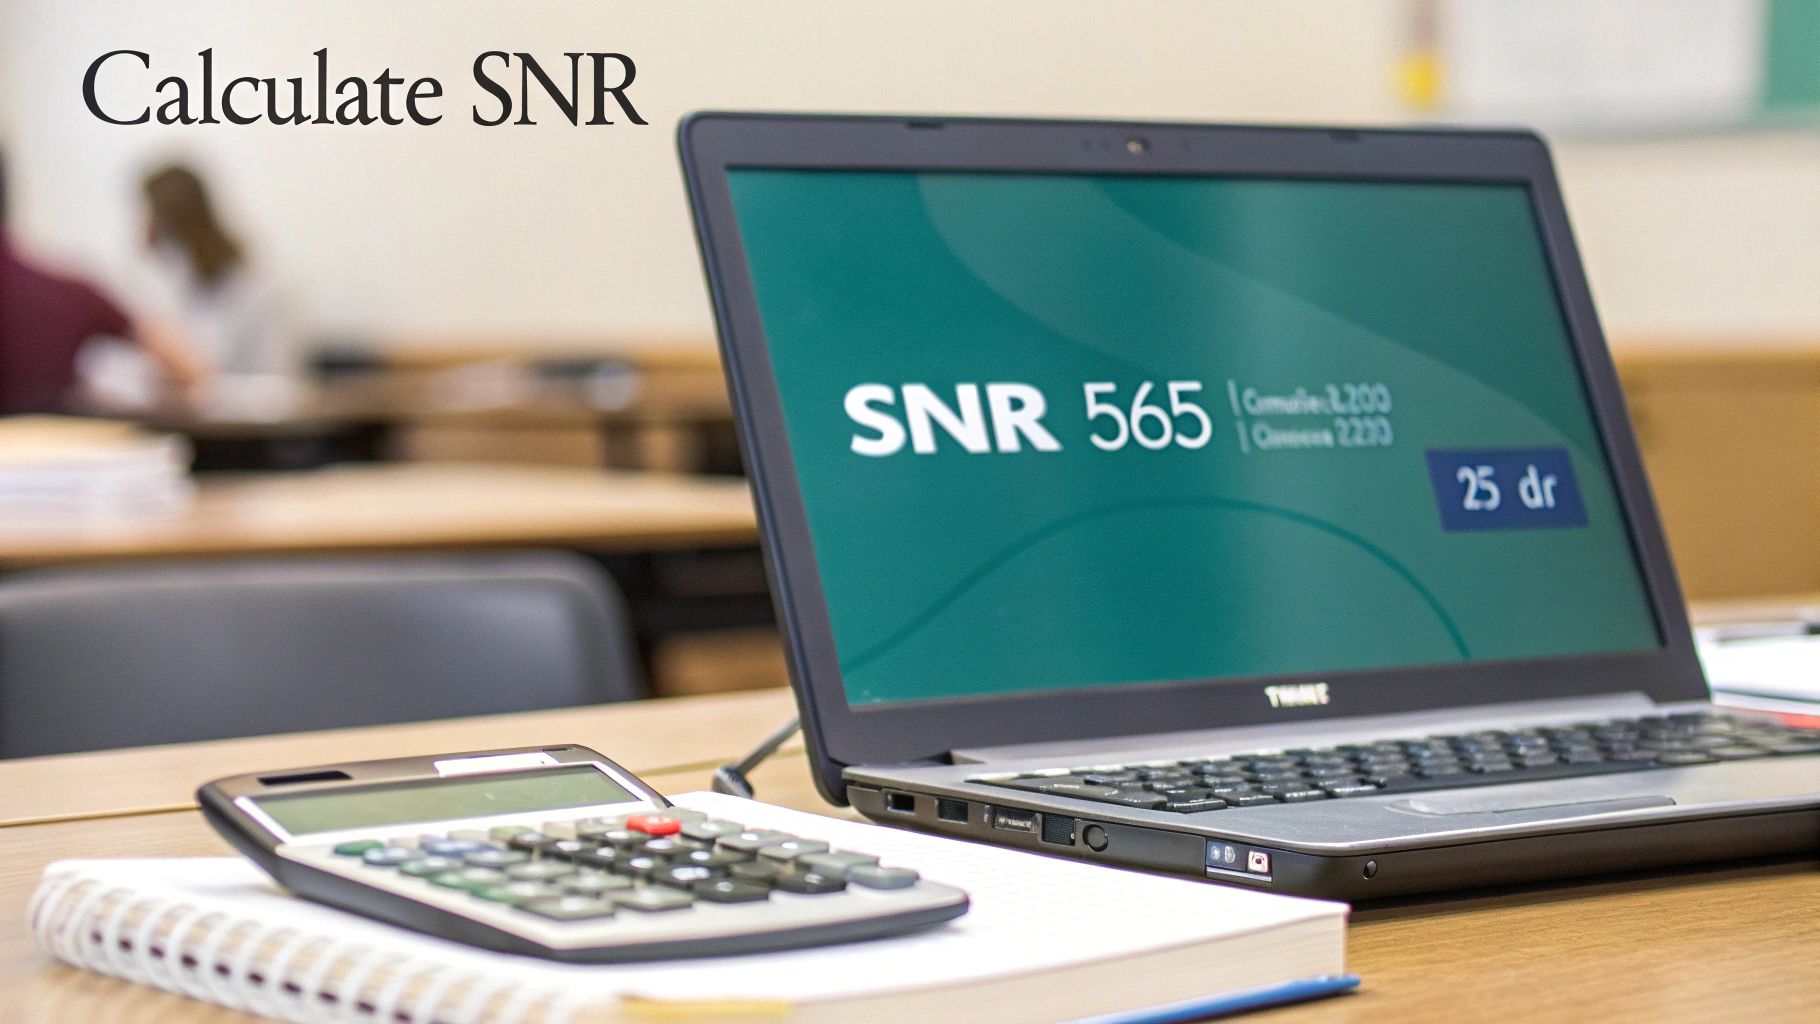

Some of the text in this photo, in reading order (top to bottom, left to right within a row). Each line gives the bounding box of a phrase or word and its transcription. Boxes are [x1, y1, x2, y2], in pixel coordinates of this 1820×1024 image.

[843, 380, 1213, 457] SNR 565
[1456, 464, 1557, 511] 25 dr
